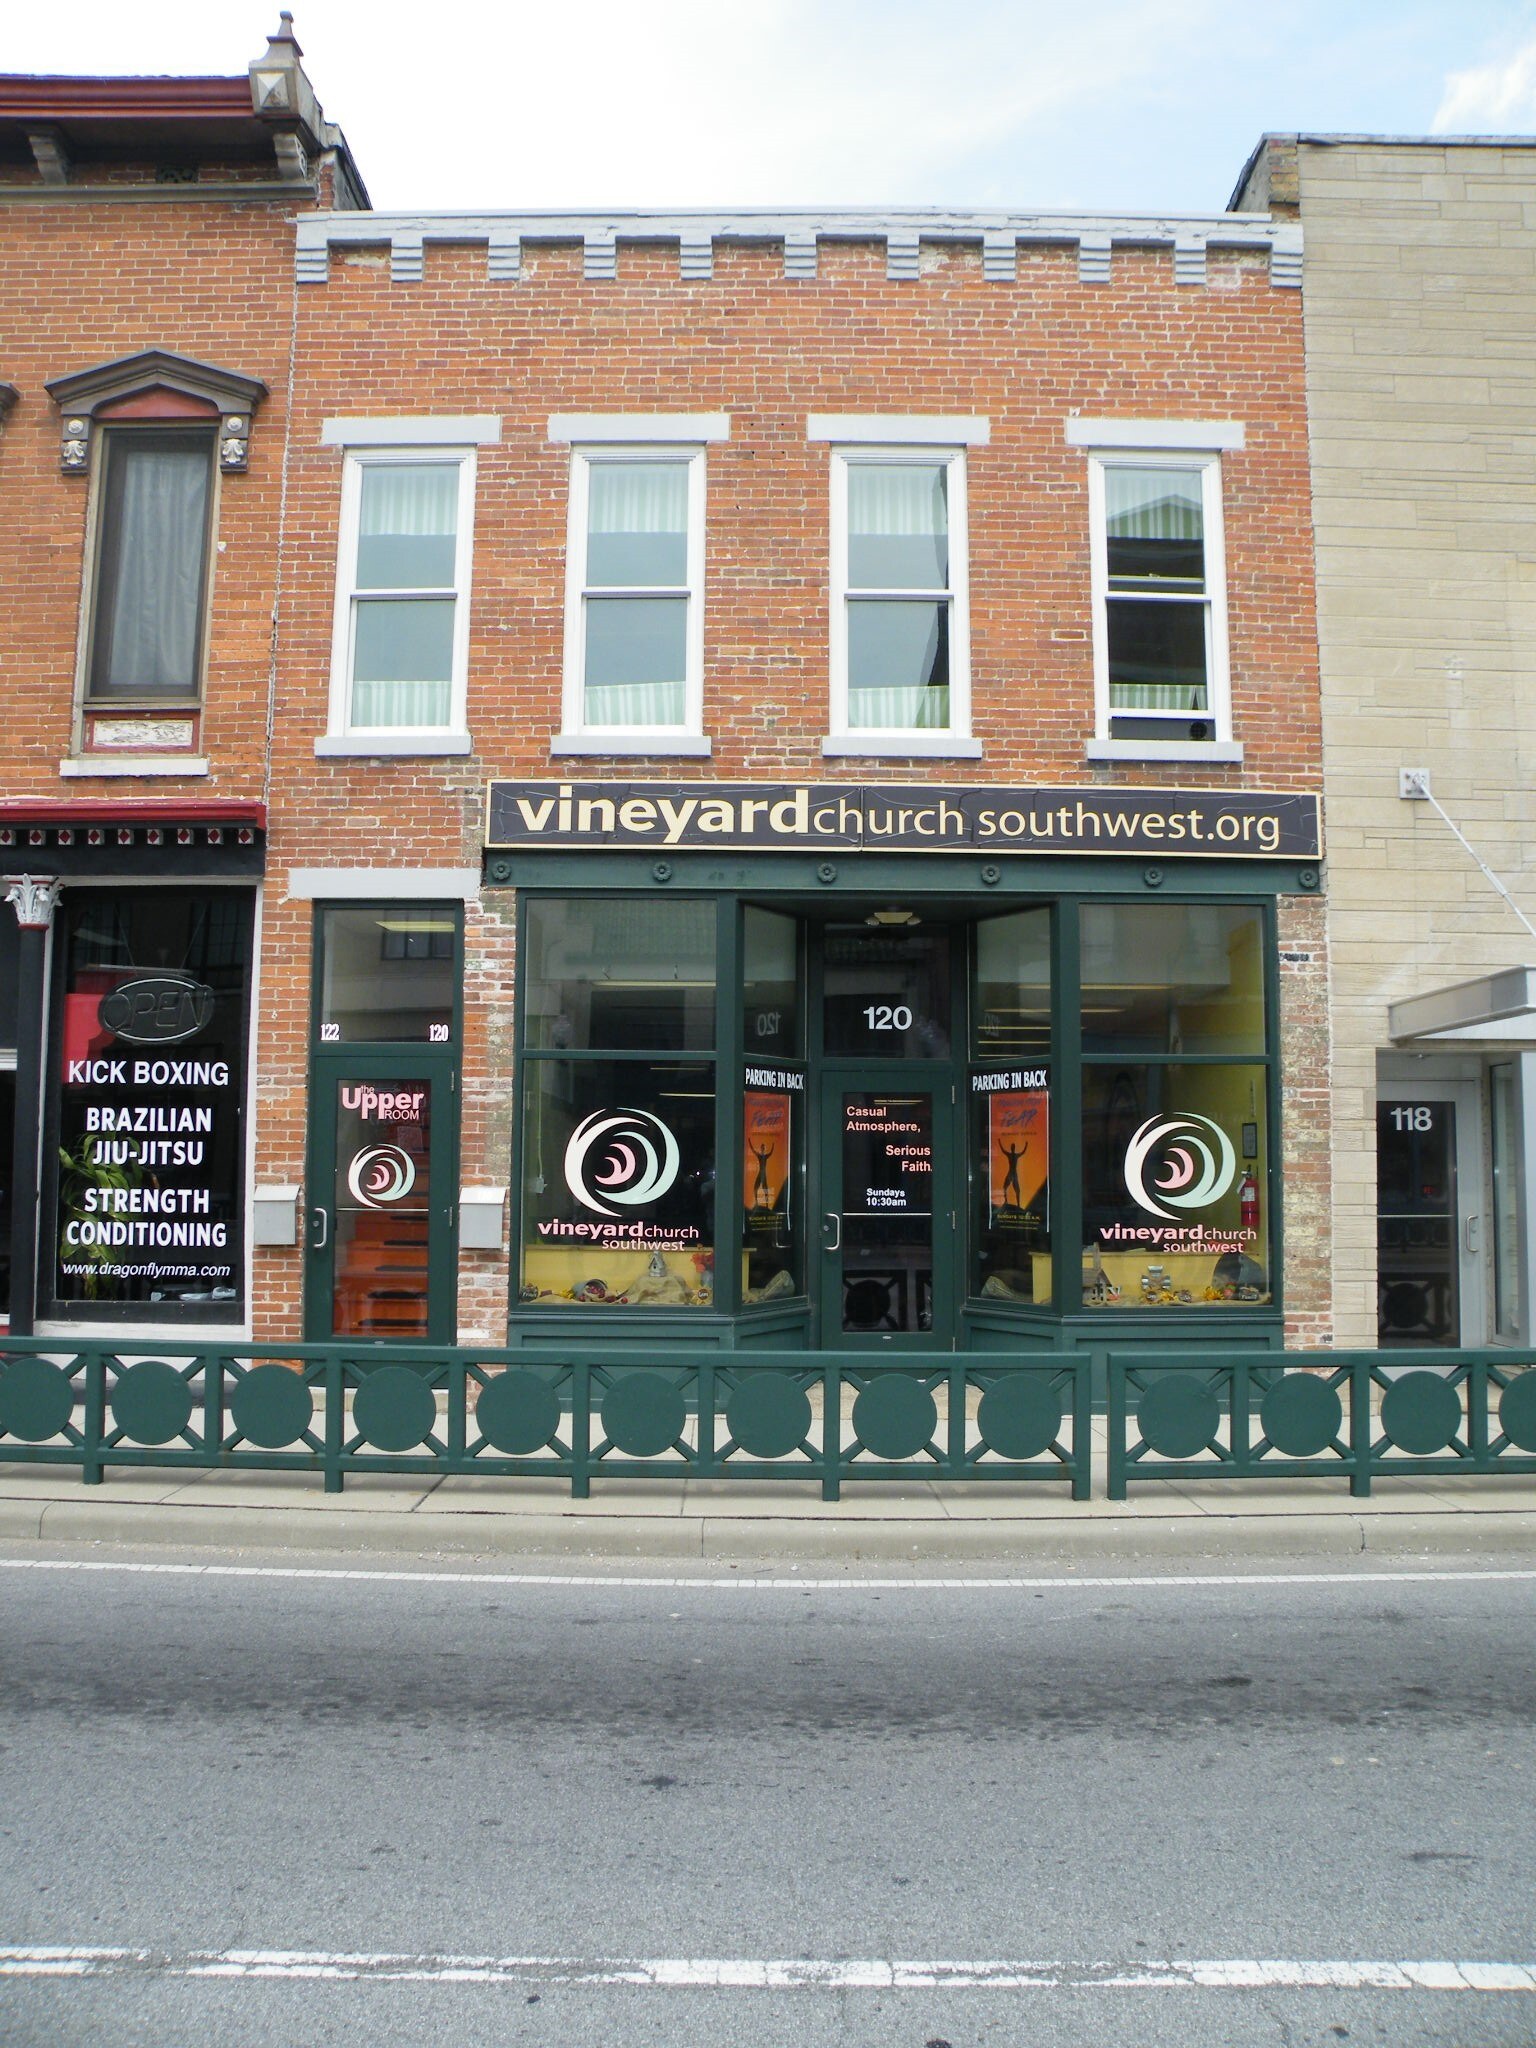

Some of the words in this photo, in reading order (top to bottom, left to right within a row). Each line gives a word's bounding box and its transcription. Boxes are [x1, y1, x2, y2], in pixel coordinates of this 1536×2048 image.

[978, 802, 1280, 851] southwest.org
[103, 991, 207, 1032] OPEN
[863, 1006, 913, 1030] 120
[320, 1023, 340, 1041] 122
[429, 1024, 449, 1042] 120
[68, 1060, 127, 1084] KICK
[134, 1061, 229, 1086] BOXING
[745, 1068, 777, 1087] PARKING
[777, 1072, 787, 1088] IN
[786, 1073, 804, 1090] BACK
[972, 1072, 1010, 1091] PARKING
[1011, 1071, 1022, 1088] IN
[1023, 1069, 1047, 1087] BACK
[342, 1087, 424, 1119] Upper
[846, 1106, 887, 1117] Casual
[86, 1107, 212, 1132] BRAZILIAN
[384, 1110, 420, 1120] ROOM
[1390, 1106, 1433, 1131] 118
[846, 1121, 921, 1133] Atmosphere,
[92, 1140, 204, 1166] JIU-JITSU
[885, 1145, 931, 1156] Serious
[84, 1188, 210, 1214] STRENGTH
[866, 1188, 906, 1198] Sundays
[866, 1197, 907, 1206] 10:30am
[66, 1220, 227, 1247] CONDITIONING
[602, 1238, 686, 1251] southwest
[1163, 1241, 1244, 1254] southwest
[63, 1262, 231, 1279] www.dragonflymma.com
